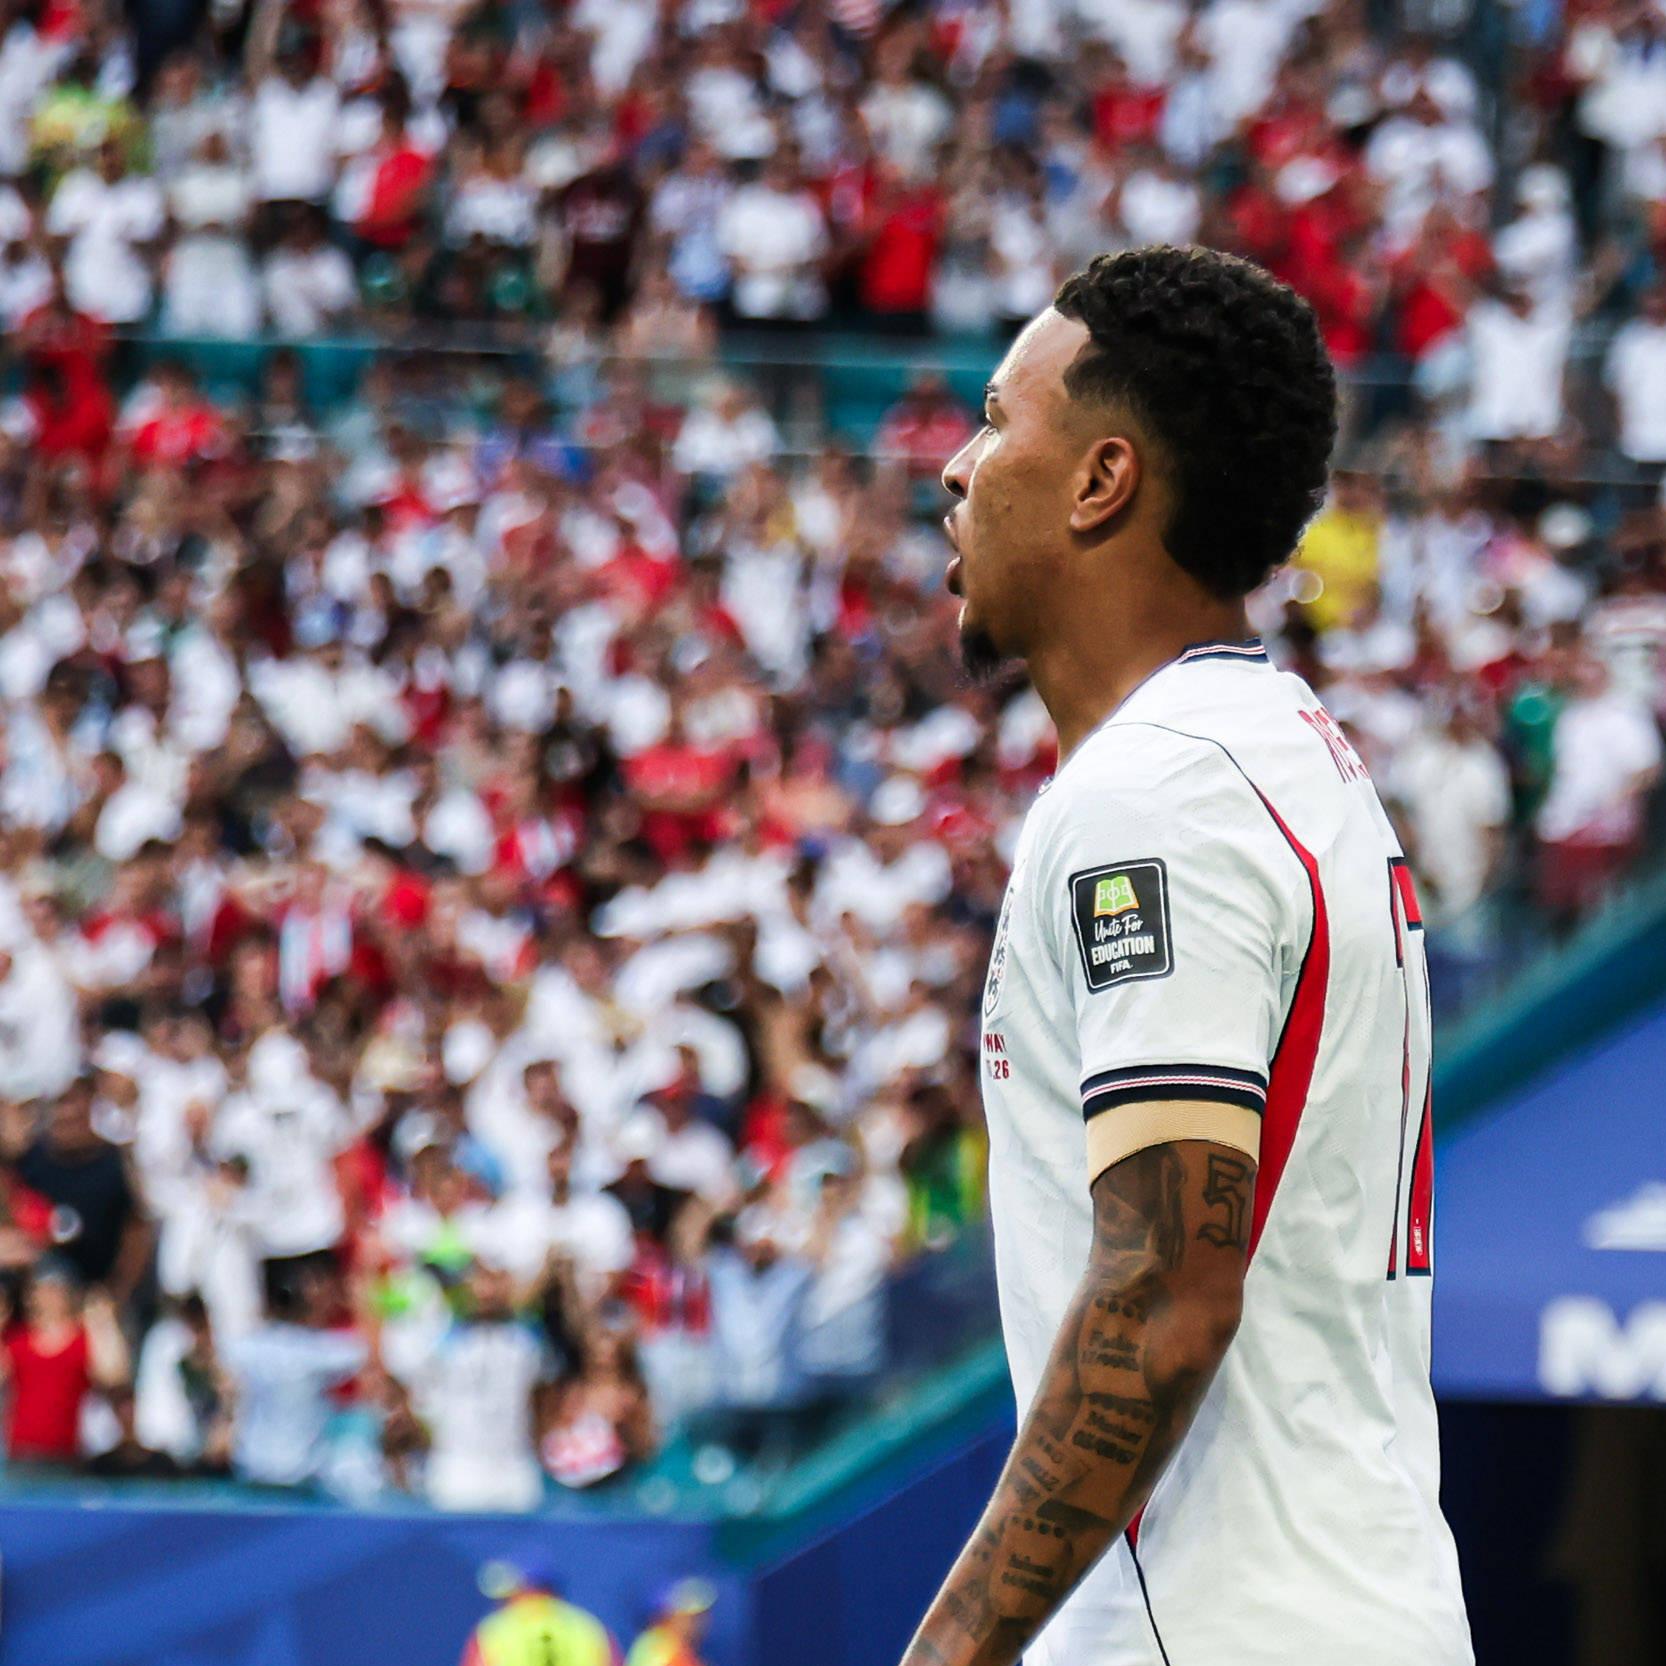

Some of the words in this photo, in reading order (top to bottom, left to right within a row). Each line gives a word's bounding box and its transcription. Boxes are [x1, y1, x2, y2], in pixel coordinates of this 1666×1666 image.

[1094, 917, 1122, 943] Unite
[1121, 913, 1144, 936] For
[1091, 935, 1155, 966] EDUCATION
